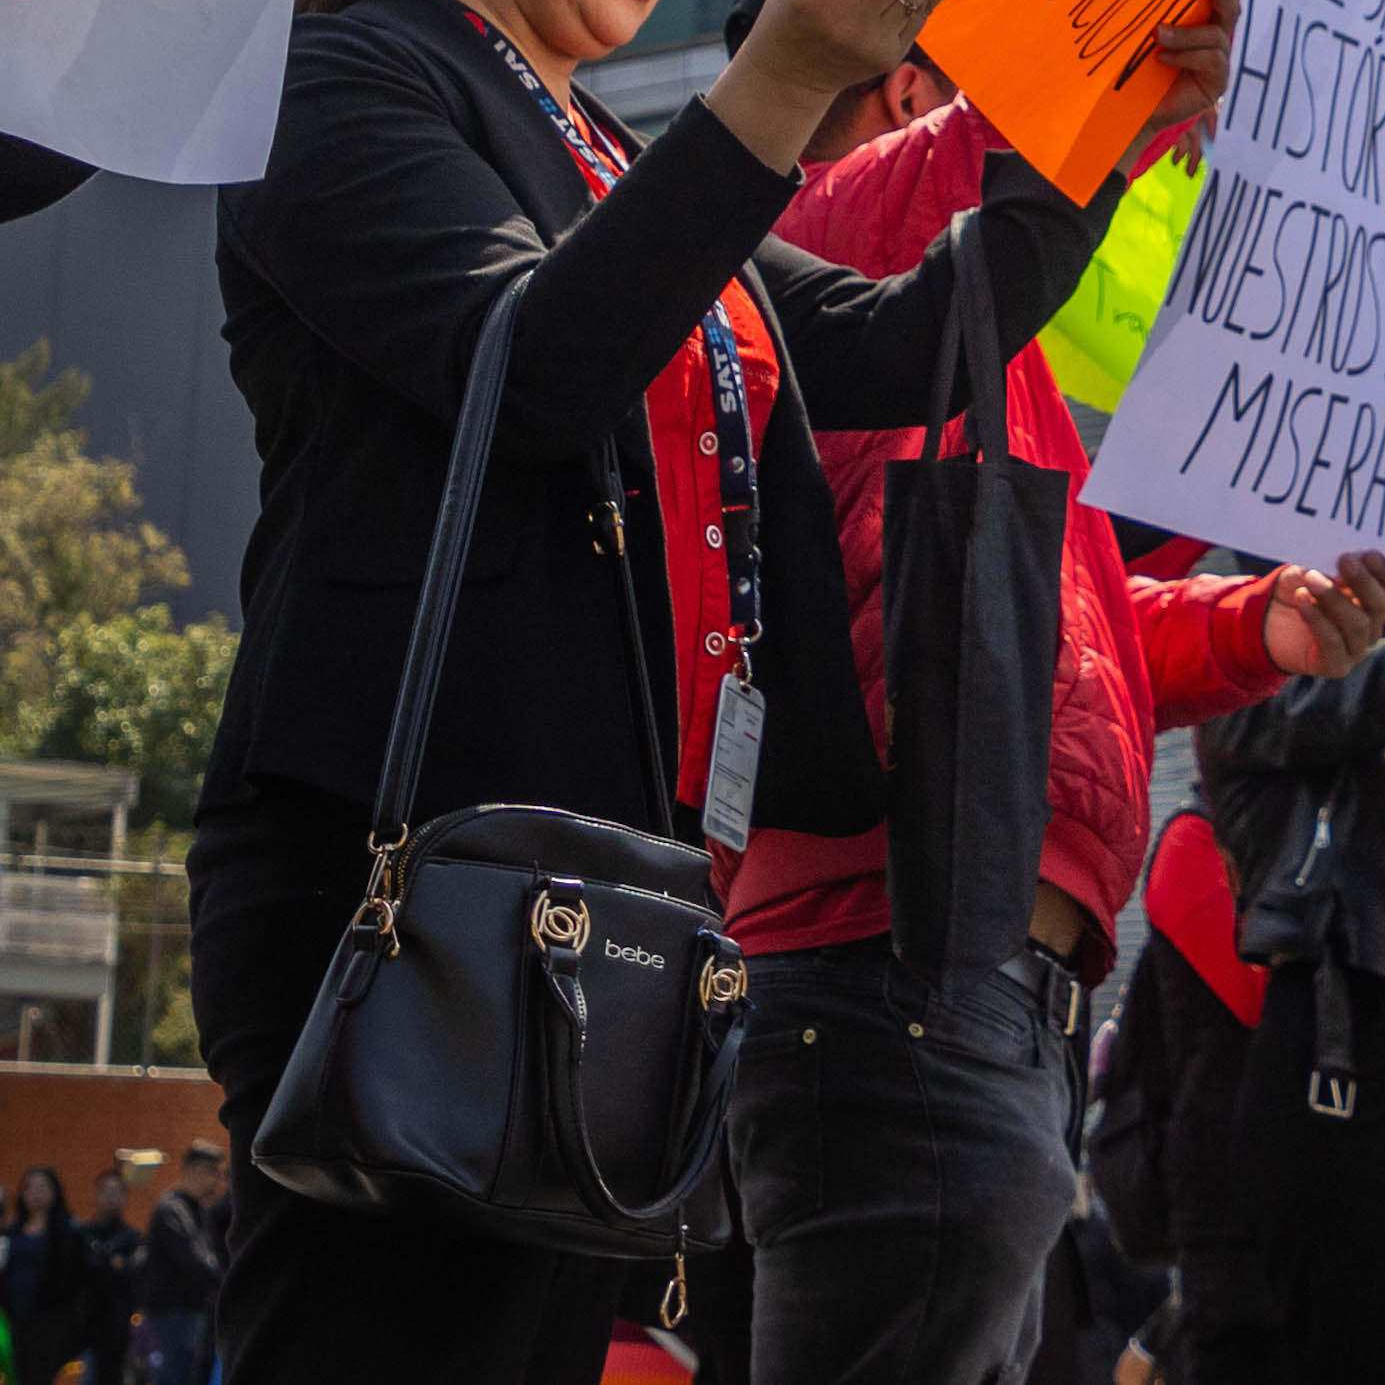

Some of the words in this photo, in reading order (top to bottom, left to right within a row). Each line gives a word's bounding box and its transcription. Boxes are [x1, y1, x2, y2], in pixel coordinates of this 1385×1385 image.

[550, 114, 601, 164] SAT
[713, 347, 738, 414] SAT
[605, 938, 665, 969] bebe
